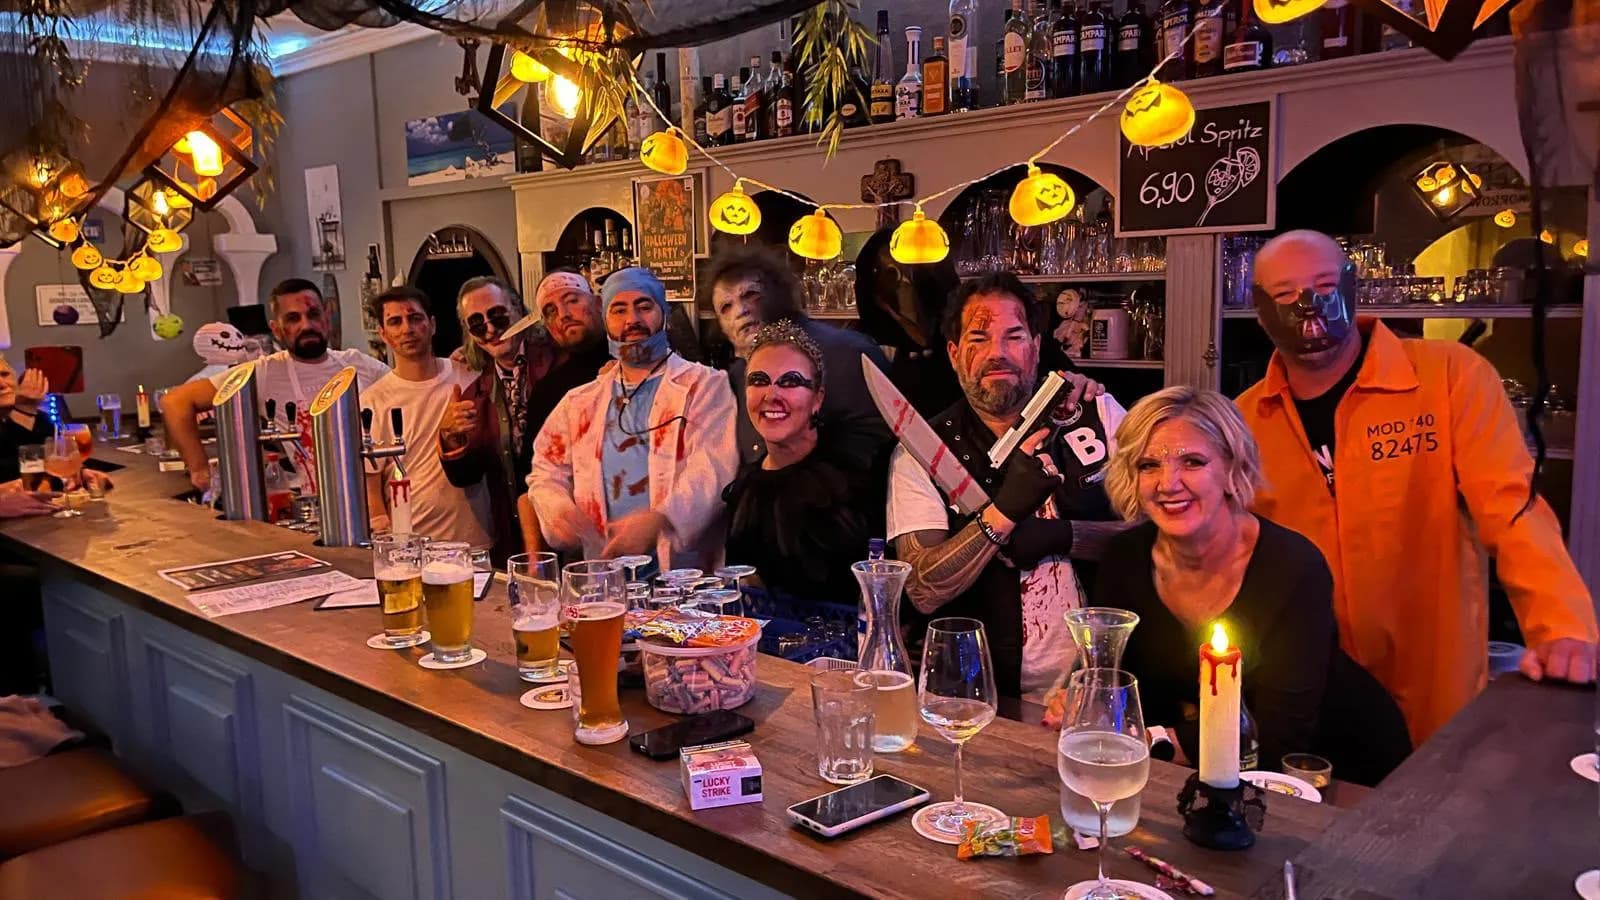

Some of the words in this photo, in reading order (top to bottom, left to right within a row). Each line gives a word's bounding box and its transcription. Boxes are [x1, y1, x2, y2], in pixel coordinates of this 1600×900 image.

[1200, 118, 1263, 148] Spritz
[1139, 171, 1195, 208] 6,90
[644, 233, 687, 248] HALLOWEEN
[653, 246, 679, 259] PARTY
[1367, 421, 1405, 438] MOD
[1063, 426, 1106, 467] B
[1371, 431, 1439, 461] 82475
[702, 776, 731, 788] LUCKY
[702, 786, 731, 798] STRIKE
